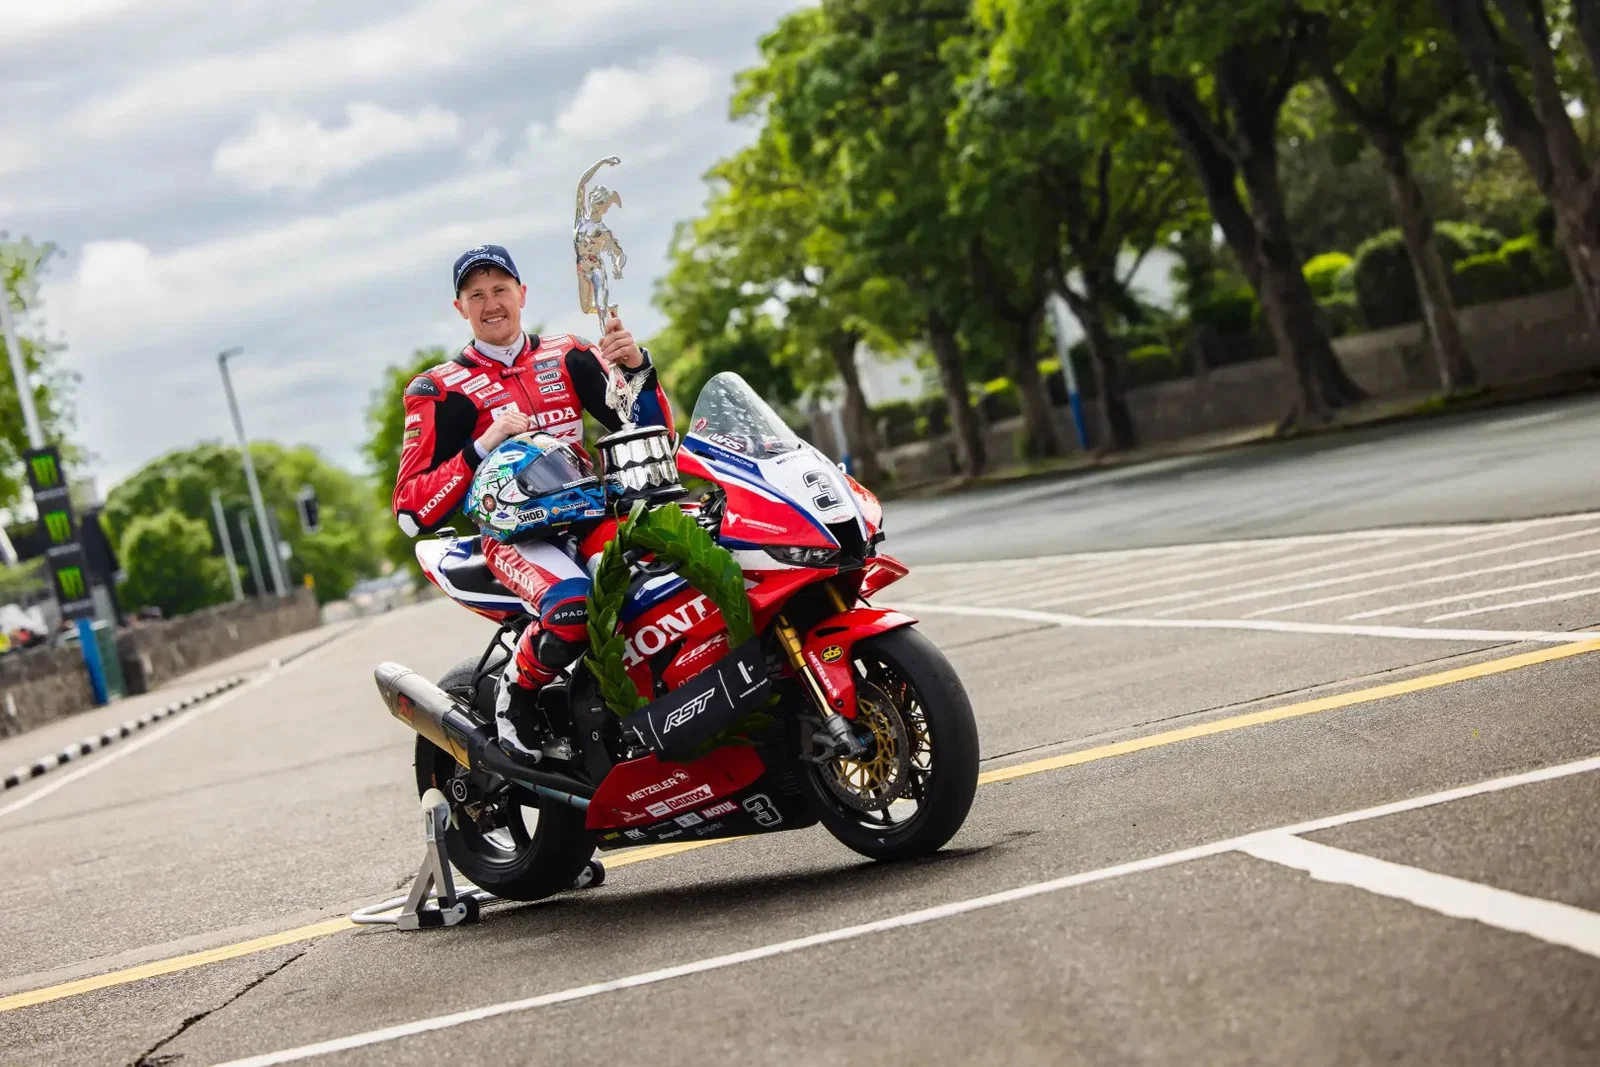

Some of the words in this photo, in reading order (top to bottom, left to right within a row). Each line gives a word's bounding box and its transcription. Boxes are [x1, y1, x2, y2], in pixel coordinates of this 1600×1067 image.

[538, 371, 558, 381] SHOEI
[529, 406, 577, 429] NDA
[709, 432, 745, 451] WRS
[418, 474, 463, 518] HONDA
[803, 469, 846, 511] 3
[517, 509, 545, 523] SHOEI
[494, 553, 535, 596] HONDA
[622, 594, 708, 671] HON
[823, 646, 841, 661] sbs
[808, 651, 833, 690] METZELER
[663, 687, 716, 734] RST
[626, 777, 679, 802] METZELER
[668, 787, 712, 808] DATATOOL
[702, 801, 737, 818] MOTUL
[742, 793, 783, 828] 3
[624, 828, 646, 839] RK
[658, 829, 683, 840] Snap-on
